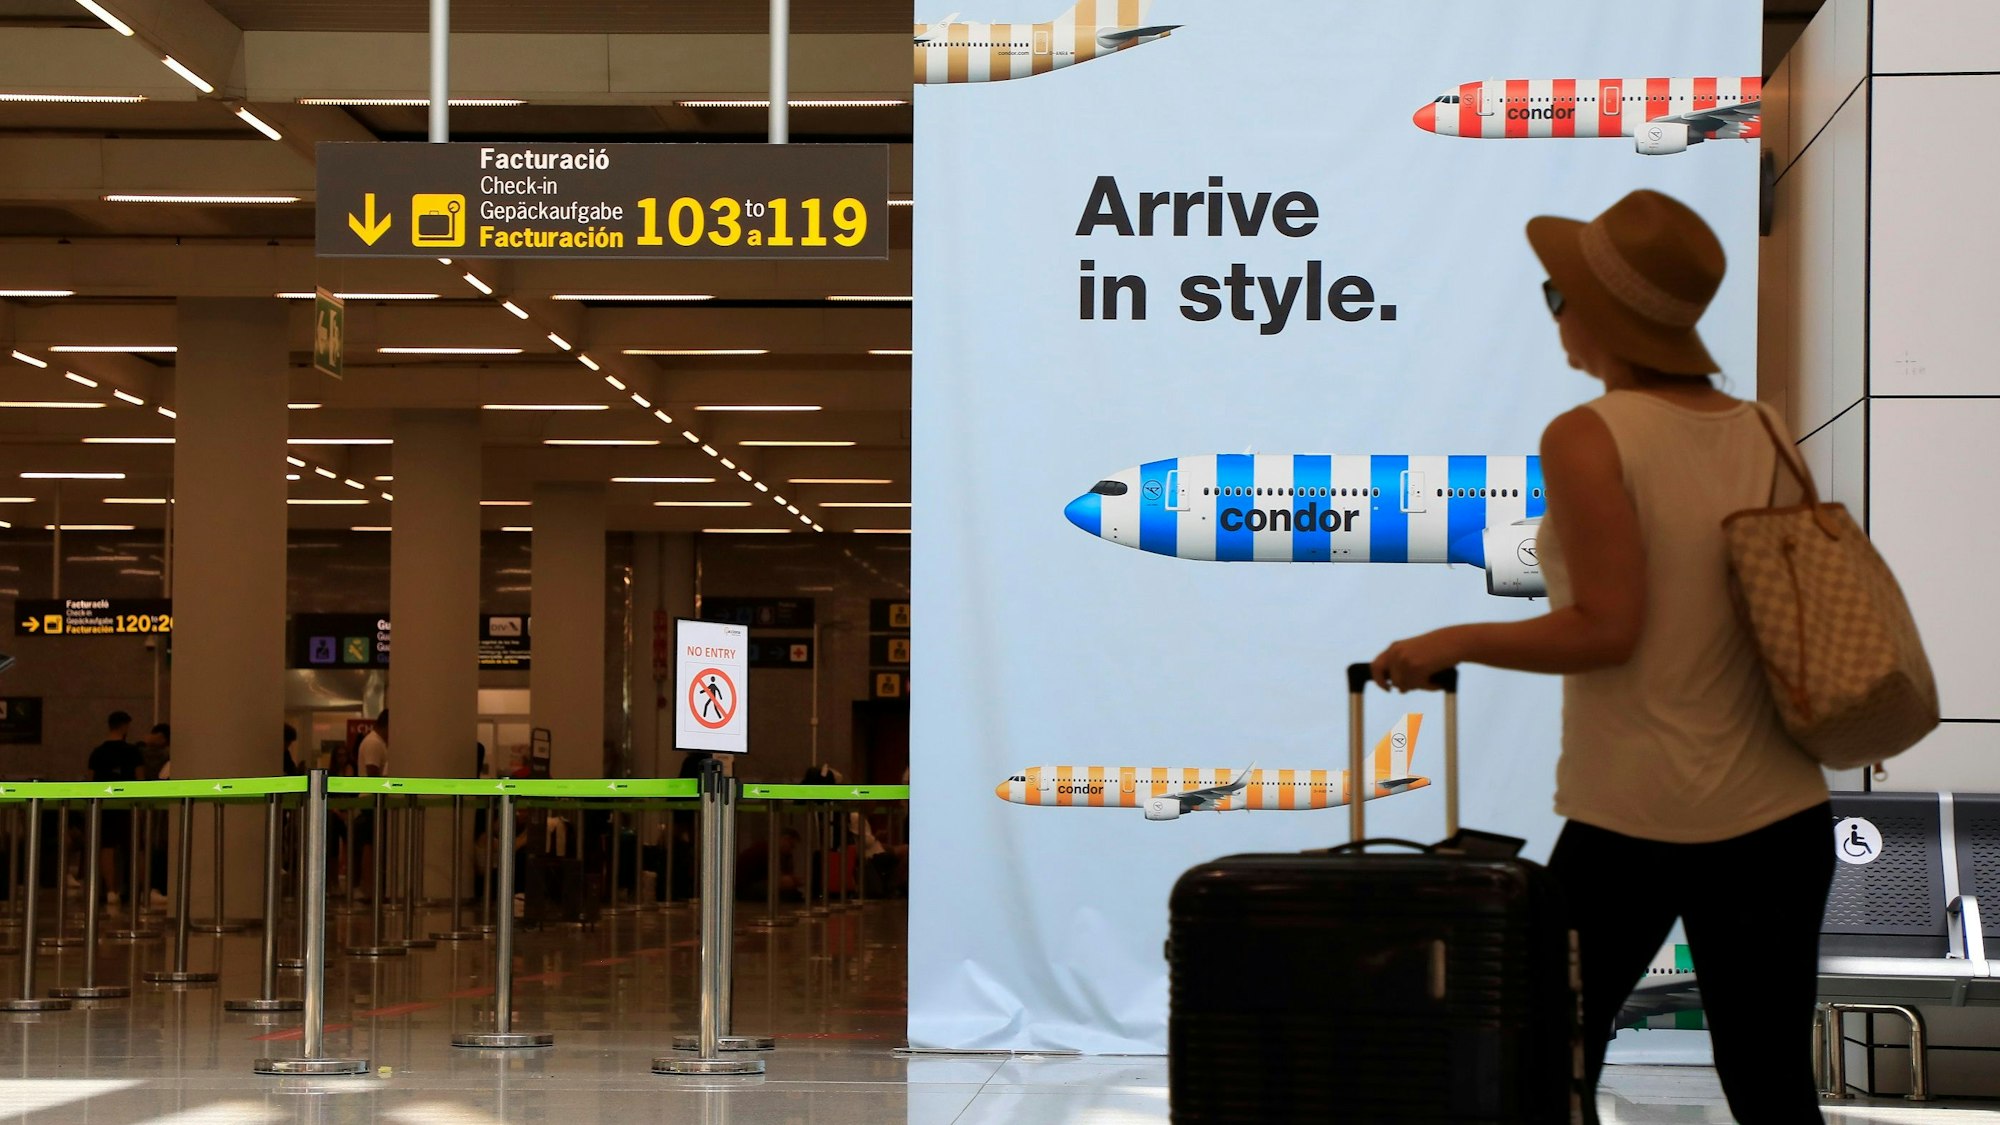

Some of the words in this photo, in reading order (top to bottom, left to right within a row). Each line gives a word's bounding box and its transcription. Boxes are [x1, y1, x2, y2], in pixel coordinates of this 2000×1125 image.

[1507, 104, 1576, 121] condor
[480, 147, 610, 170] Facturació
[480, 175, 558, 195] Check-in
[480, 201, 624, 225] Gepäckaufgabe
[744, 199, 765, 218] to
[1075, 175, 1320, 238] Arrive
[637, 197, 742, 247] 103
[767, 197, 868, 247] 119
[480, 225, 624, 248] Facturación
[746, 230, 763, 247] a
[1080, 259, 1147, 321] in
[1179, 260, 1398, 336] style.
[1220, 502, 1360, 533] condor
[66, 599, 109, 609] Facturació
[66, 625, 114, 634] Facturación
[116, 614, 151, 633] 120
[158, 614, 173, 633] 2
[688, 646, 702, 657] NO
[705, 647, 736, 659] ENTRY
[1057, 782, 1104, 795] condor
